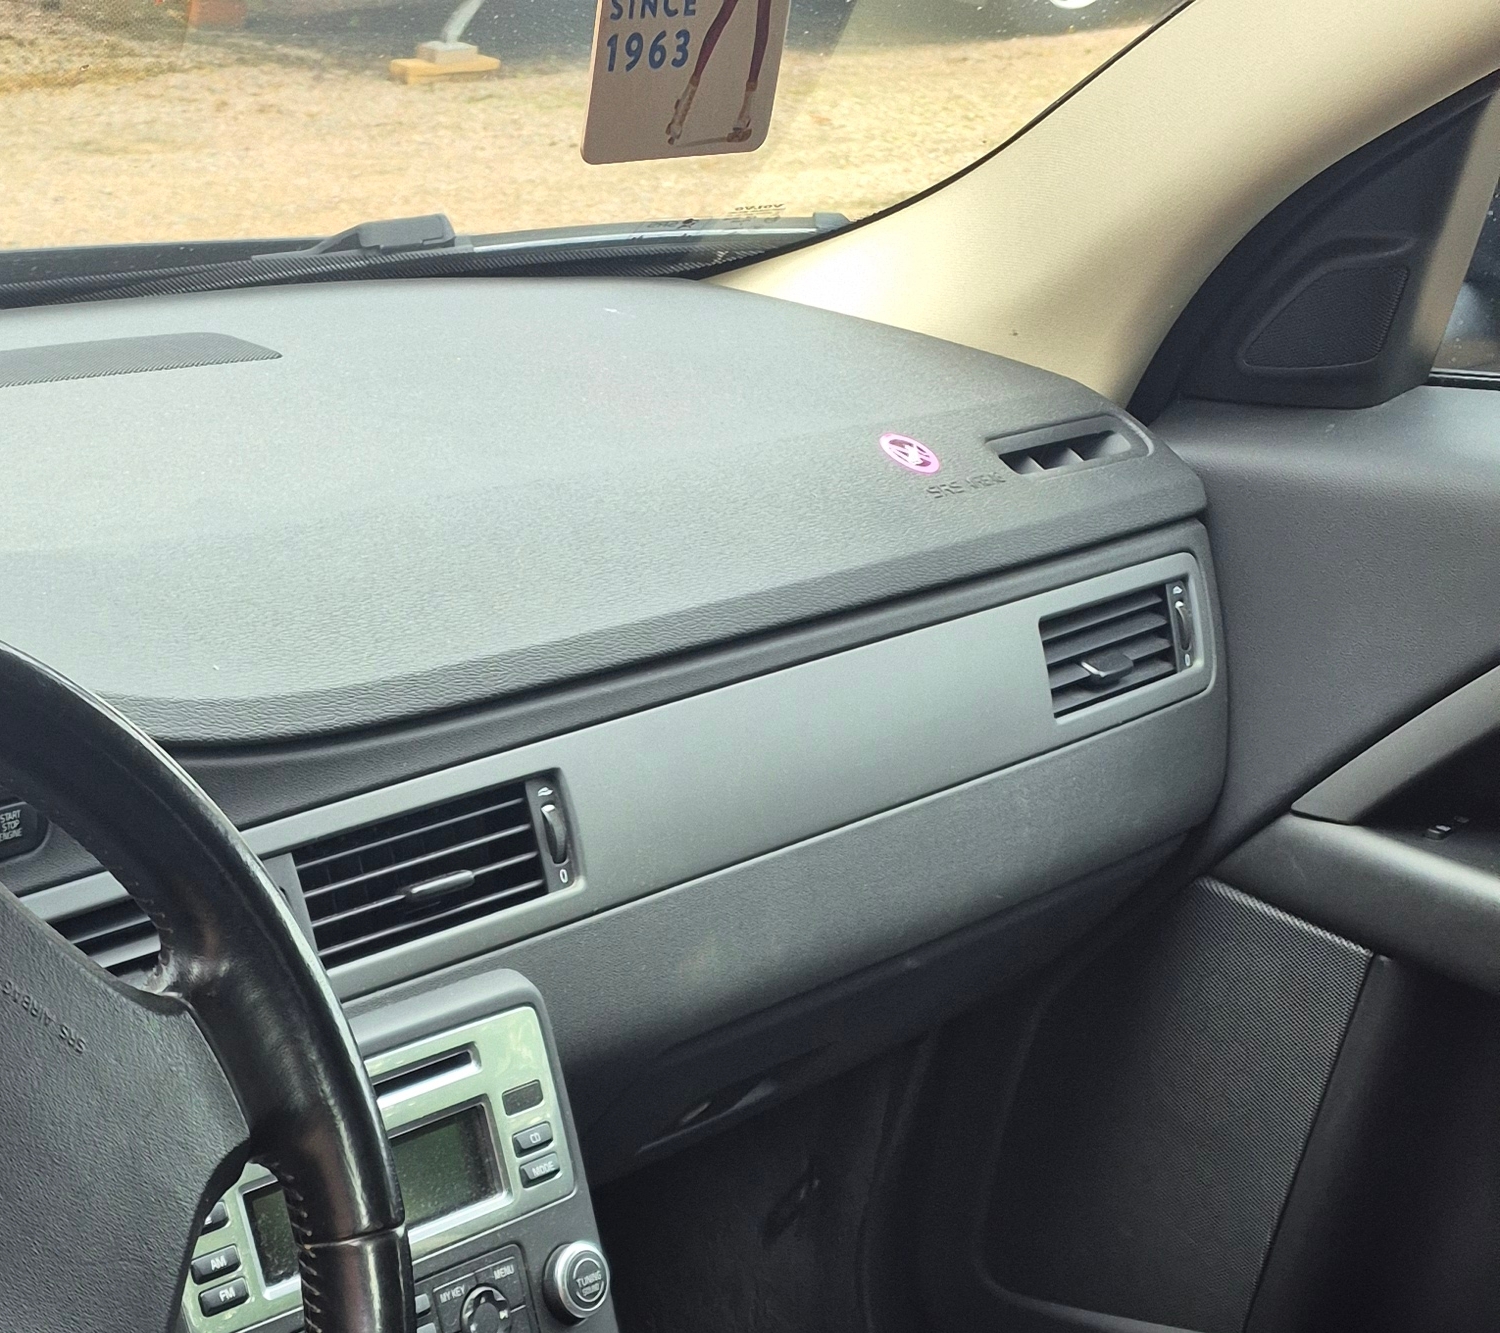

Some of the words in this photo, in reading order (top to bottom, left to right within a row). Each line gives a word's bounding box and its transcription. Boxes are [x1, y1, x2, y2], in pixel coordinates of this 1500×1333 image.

[610, 0, 697, 21] SINCE
[607, 29, 690, 72] 1963
[0, 809, 21, 822] START
[2, 820, 20, 832] STOP
[531, 1161, 556, 1177] MODE
[210, 1255, 227, 1271] AM
[493, 1265, 515, 1280] MENU
[219, 1286, 236, 1302] FM
[451, 1284, 466, 1300] KEY
